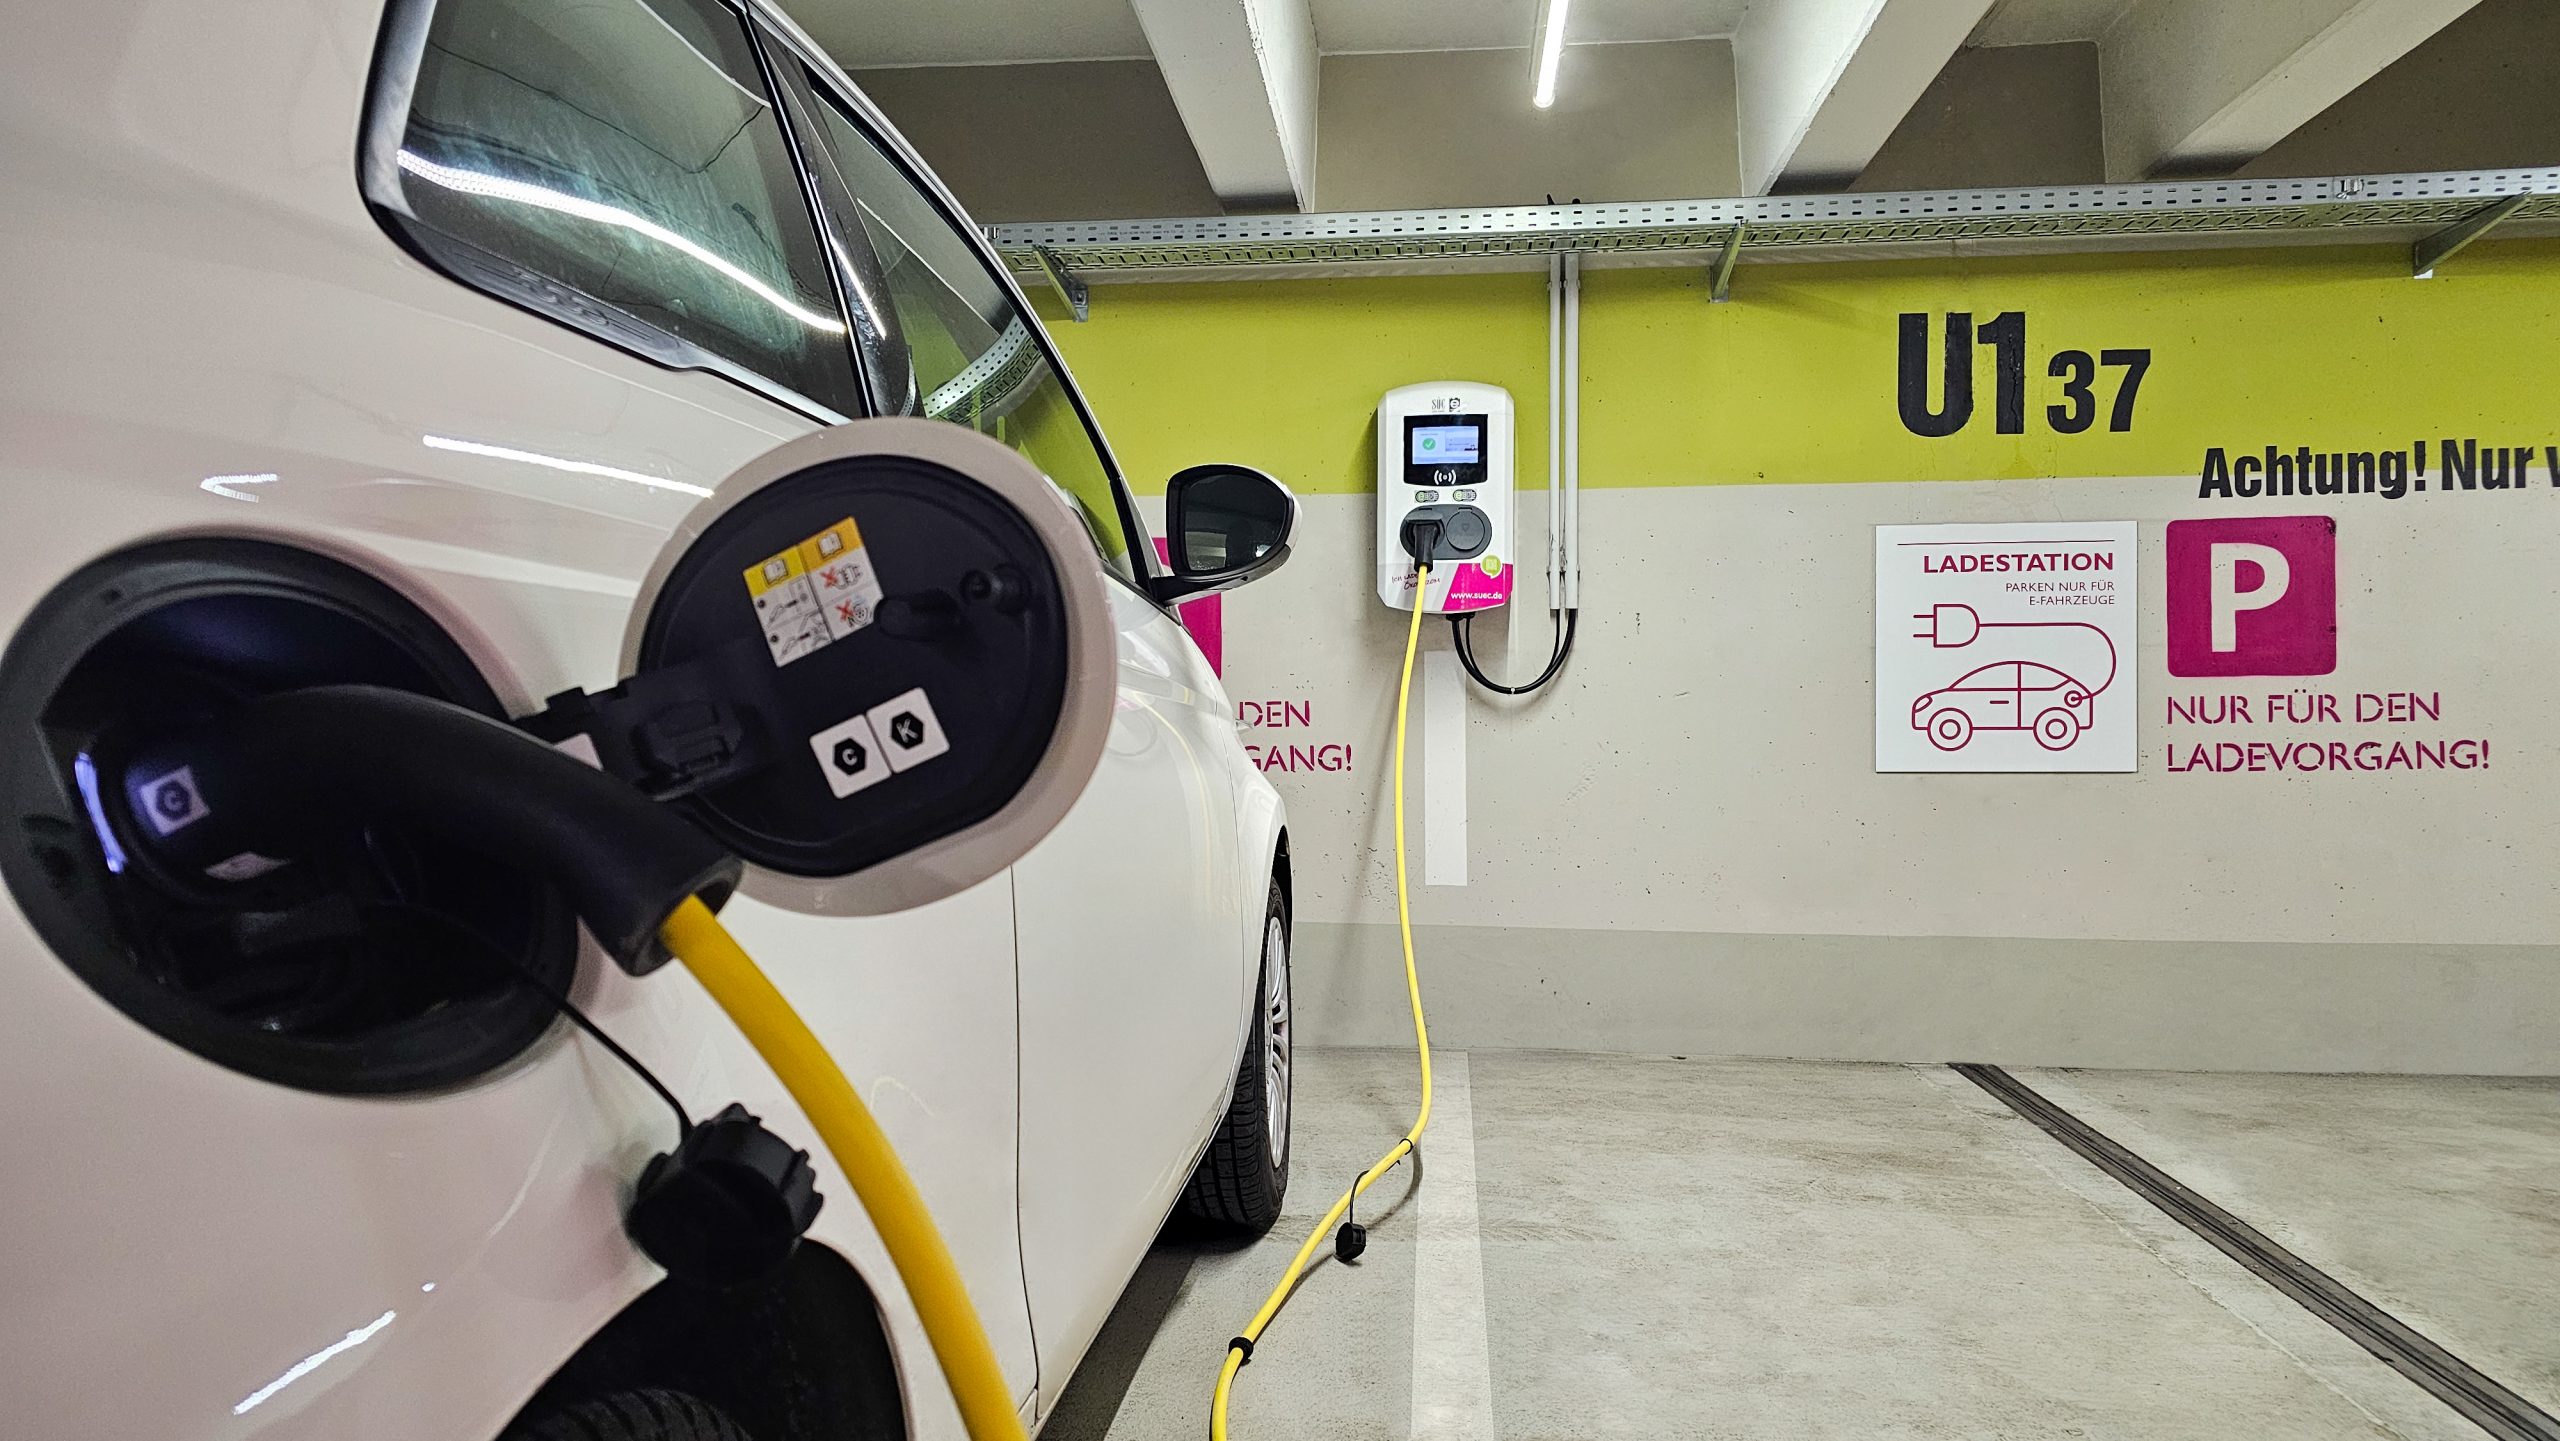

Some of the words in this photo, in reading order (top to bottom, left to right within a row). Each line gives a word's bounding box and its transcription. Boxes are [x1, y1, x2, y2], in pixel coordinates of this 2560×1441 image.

[1898, 312, 2026, 437] U1
[2047, 349, 2151, 434] 37
[2199, 440, 2427, 499] Achtung!
[2441, 439, 2534, 491] Nur
[1924, 552, 2114, 573] LADESTATION
[1451, 592, 1502, 600] www.suec.de
[2005, 582, 2054, 593] PARKEN
[2059, 581, 2086, 592] NUR
[2091, 580, 2115, 592] FÜR
[2029, 594, 2115, 606] E-FAHRZEUGE
[2210, 543, 2290, 652] P
[1239, 700, 1310, 728] DEN
[2167, 695, 2254, 725] NUR
[2268, 689, 2342, 724] FÜR
[2356, 692, 2440, 723] DEN
[2167, 739, 2489, 772] LADEVORGANG!
